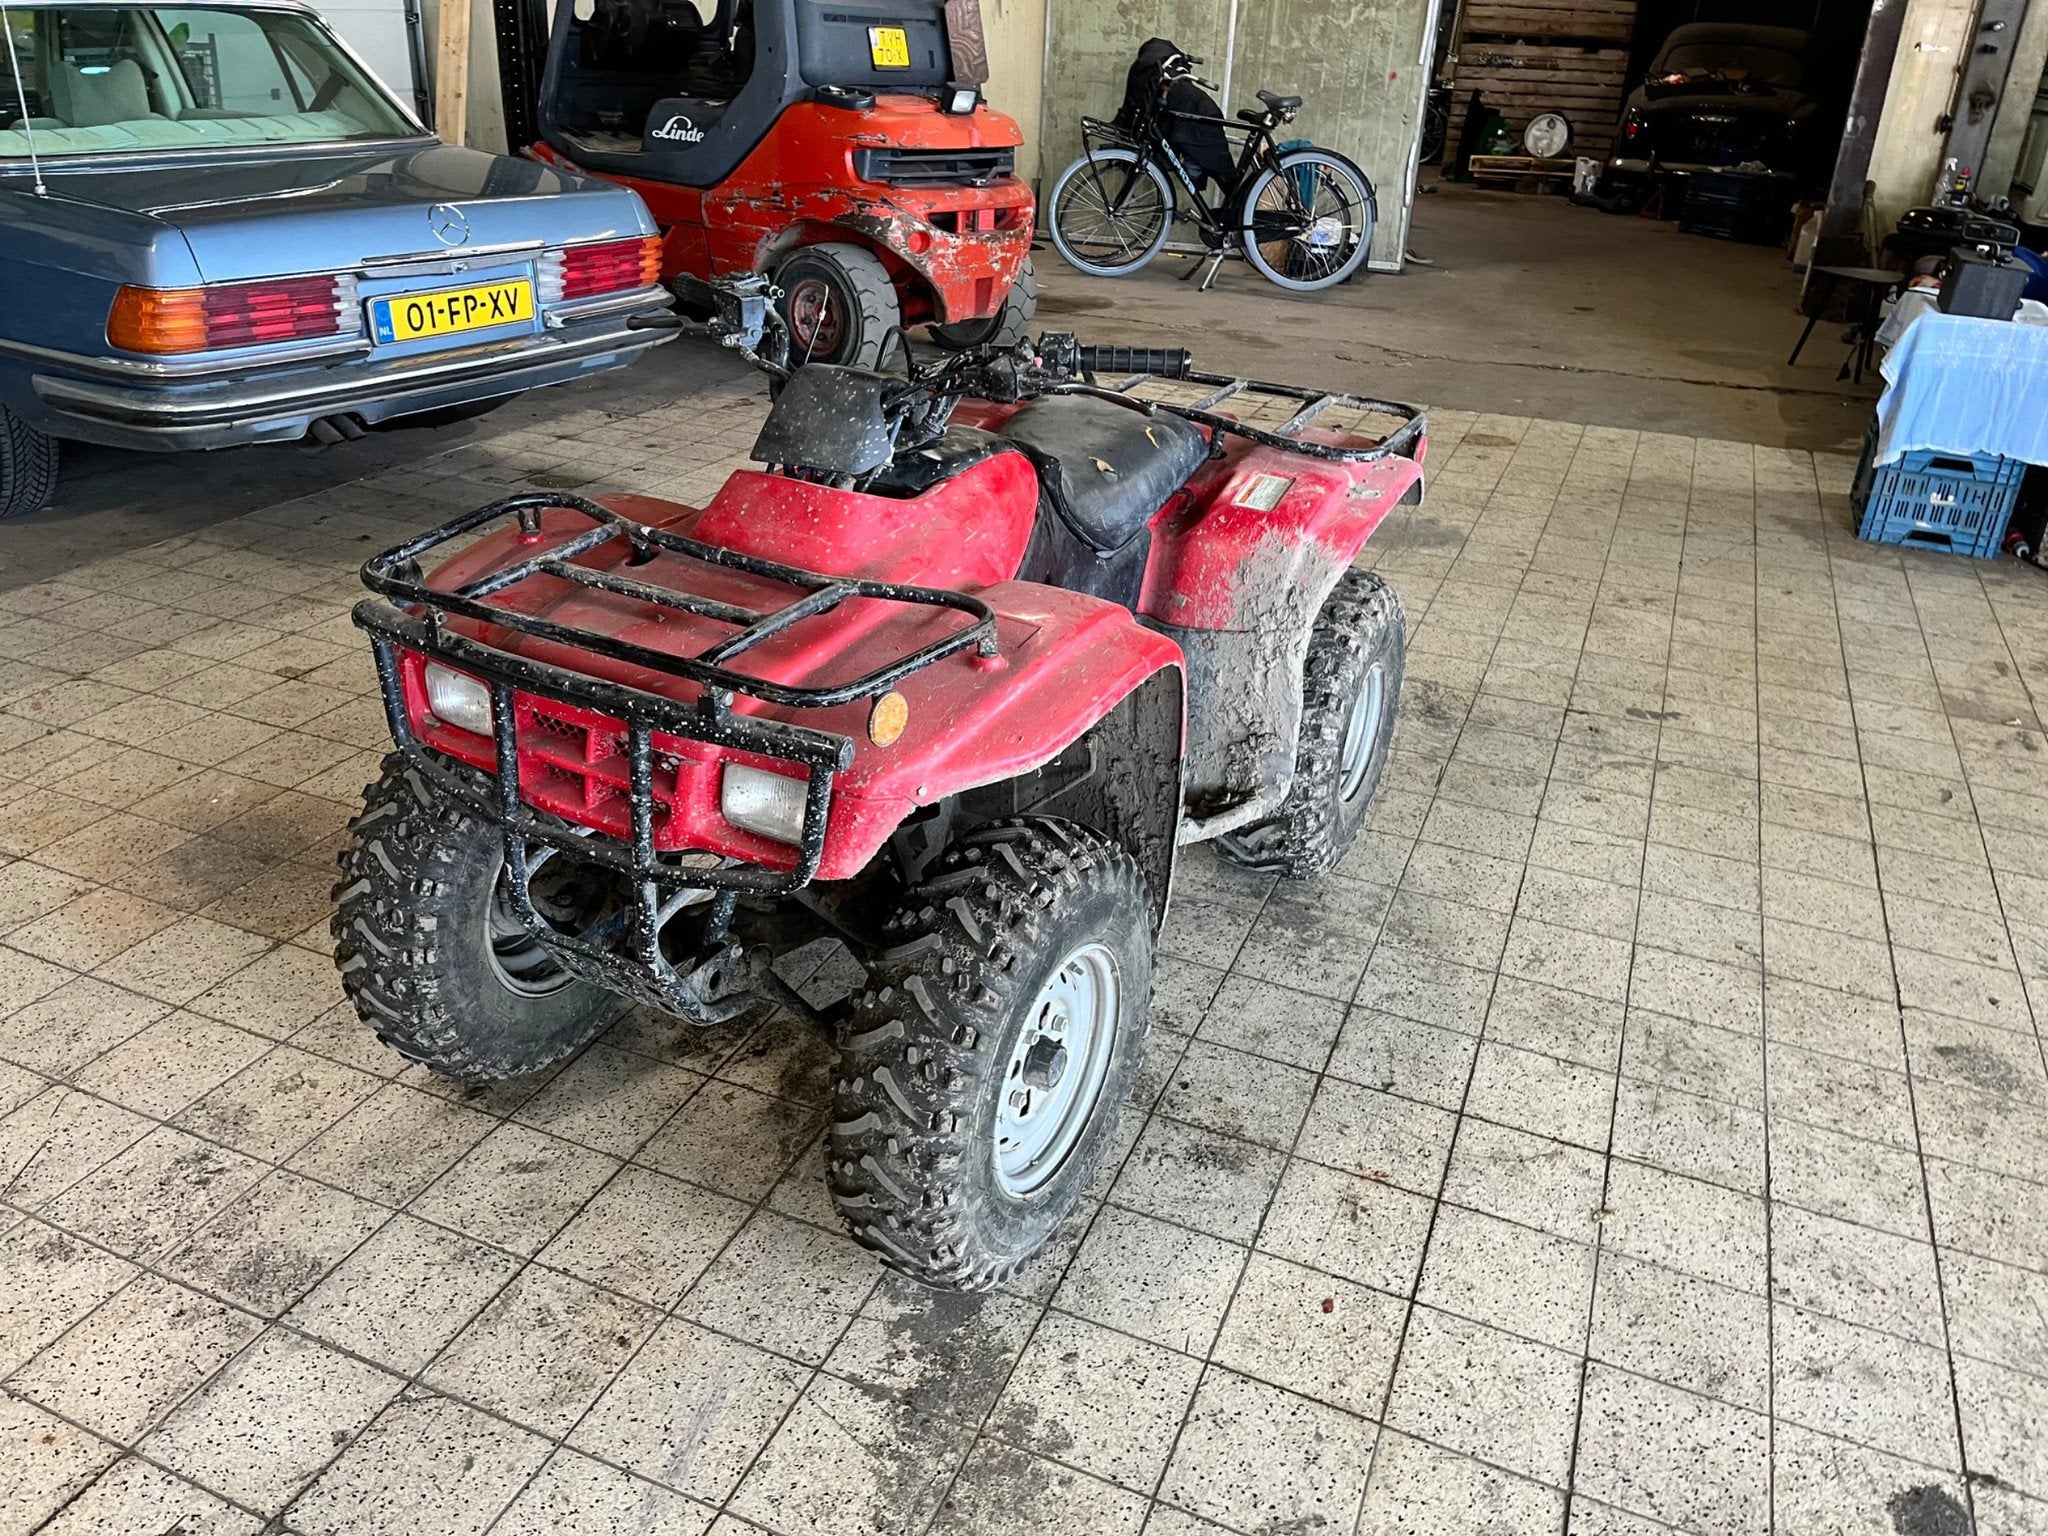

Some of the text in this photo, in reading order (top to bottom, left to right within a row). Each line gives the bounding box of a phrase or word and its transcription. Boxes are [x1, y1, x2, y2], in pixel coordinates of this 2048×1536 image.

[651, 115, 705, 142] Linde
[406, 288, 518, 332] 01-FP-XV
[379, 326, 393, 336] NL
